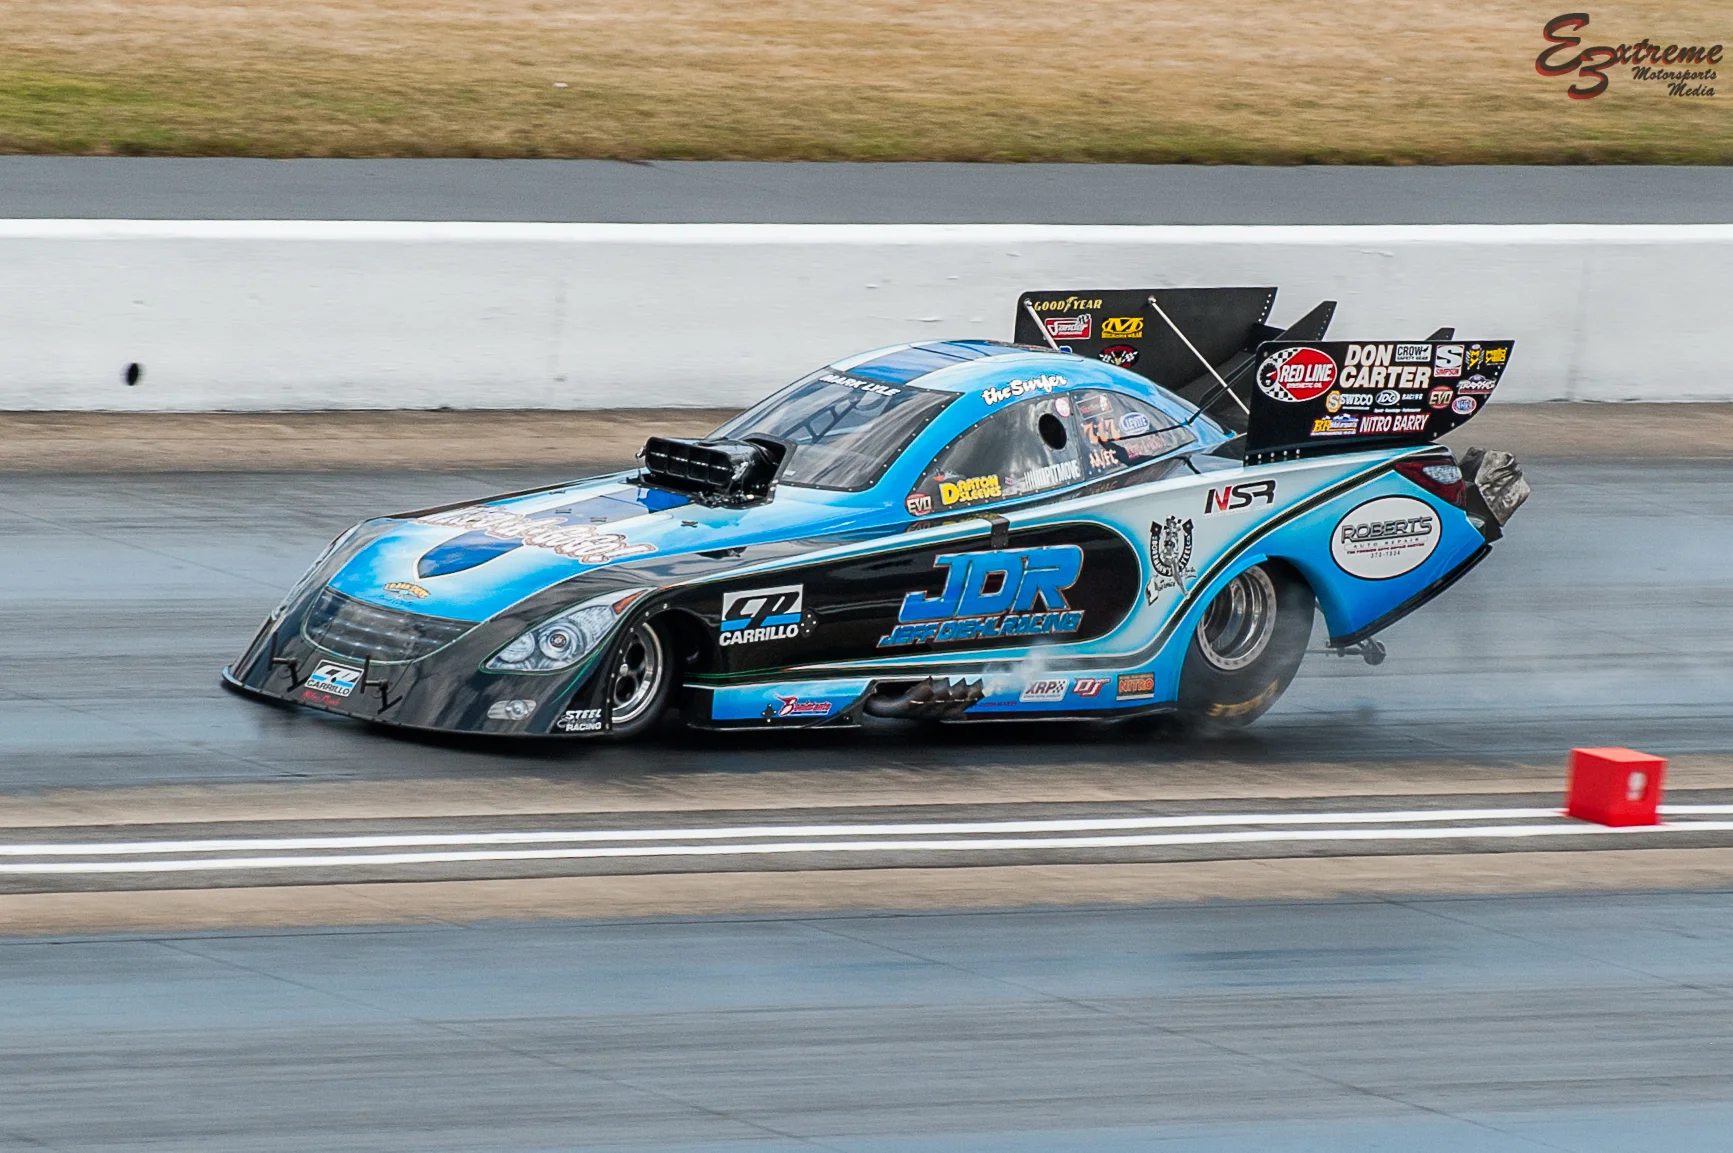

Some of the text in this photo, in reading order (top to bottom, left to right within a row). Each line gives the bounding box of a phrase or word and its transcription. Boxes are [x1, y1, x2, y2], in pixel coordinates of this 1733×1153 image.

[1344, 344, 1393, 367] DON
[1397, 346, 1423, 356] CROW
[1280, 363, 1333, 382] RED LINE
[1340, 366, 1432, 389] CARTER
[981, 387, 1012, 406] the
[1429, 391, 1454, 404] EVO
[1359, 414, 1430, 433] NITRO BARRY
[906, 495, 932, 513] EVO
[1203, 479, 1277, 514] NSR
[899, 544, 1084, 623] JDR
[719, 624, 799, 647] CARRILLO
[876, 610, 1085, 648] JEFF DIEHL RACING
[306, 679, 351, 696] CARRILLO
[1025, 681, 1057, 695] XRP
[1118, 678, 1155, 693] NITRO
[565, 709, 602, 720] STEEL
[565, 721, 602, 732] RACING
